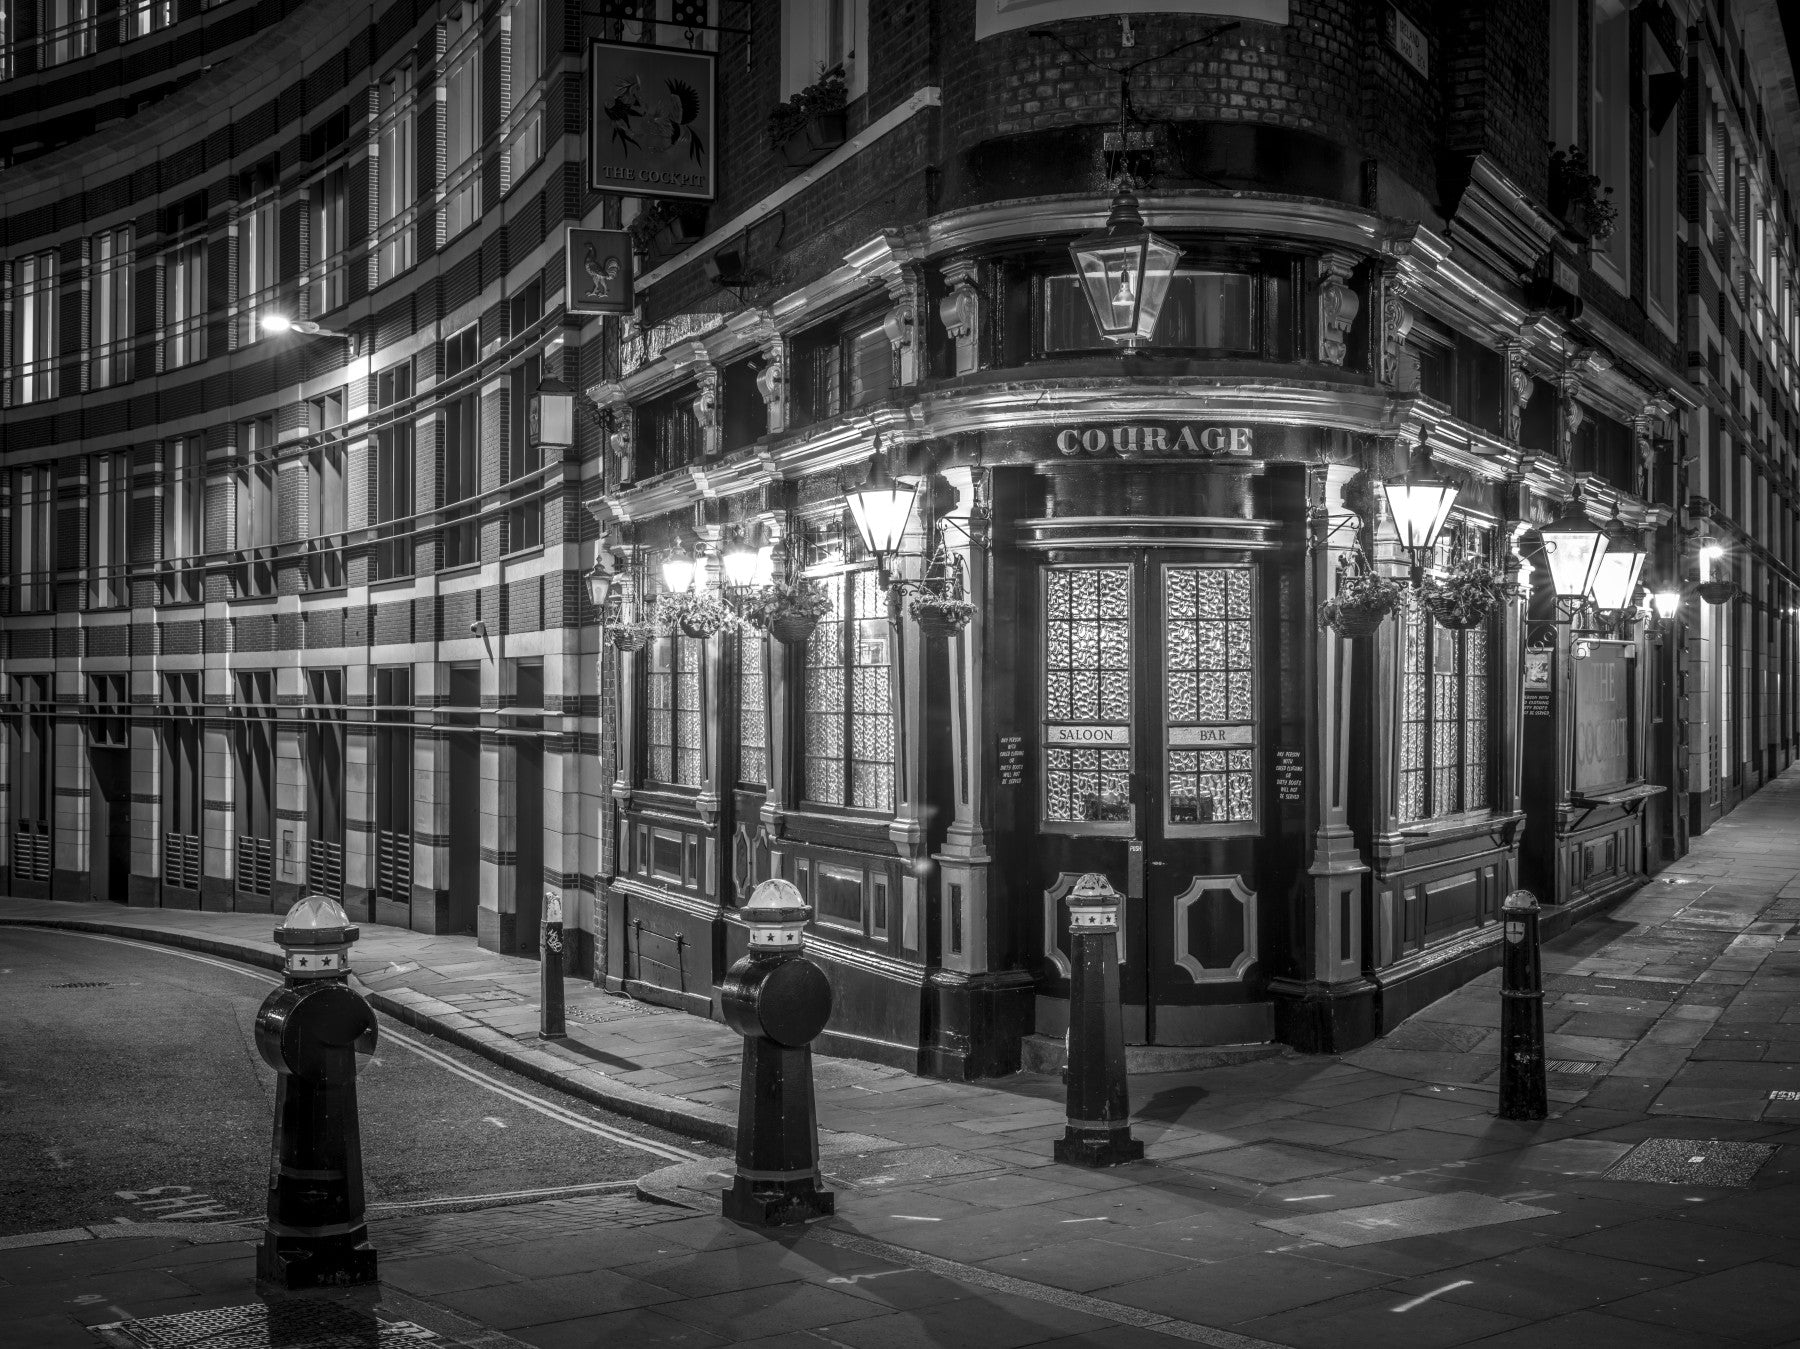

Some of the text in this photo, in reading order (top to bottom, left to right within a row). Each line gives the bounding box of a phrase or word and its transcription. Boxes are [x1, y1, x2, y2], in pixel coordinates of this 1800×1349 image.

[603, 166, 705, 187] THE COCKPIT
[1057, 426, 1252, 456] COURAGE
[1591, 662, 1615, 702] THE
[1060, 729, 1226, 741] SALOON BAR
[1577, 718, 1627, 766] COCKPIT
